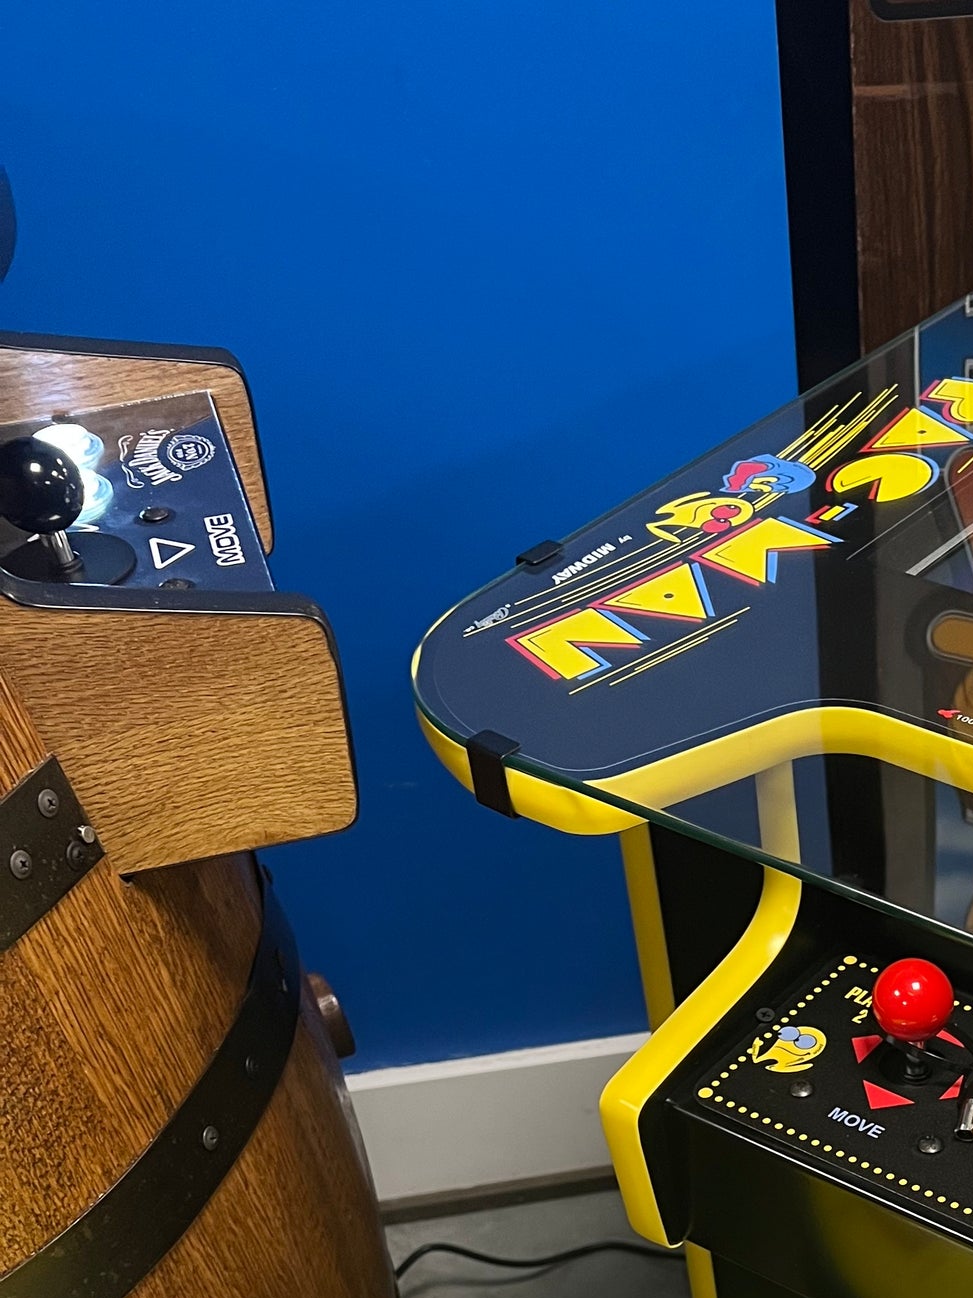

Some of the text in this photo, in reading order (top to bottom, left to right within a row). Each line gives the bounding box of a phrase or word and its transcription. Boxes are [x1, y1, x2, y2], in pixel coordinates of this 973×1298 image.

[204, 513, 245, 567] MOVE
[551, 542, 617, 586] MIDWAY
[851, 1009, 868, 1025] 2
[826, 1105, 886, 1140] MOVE
